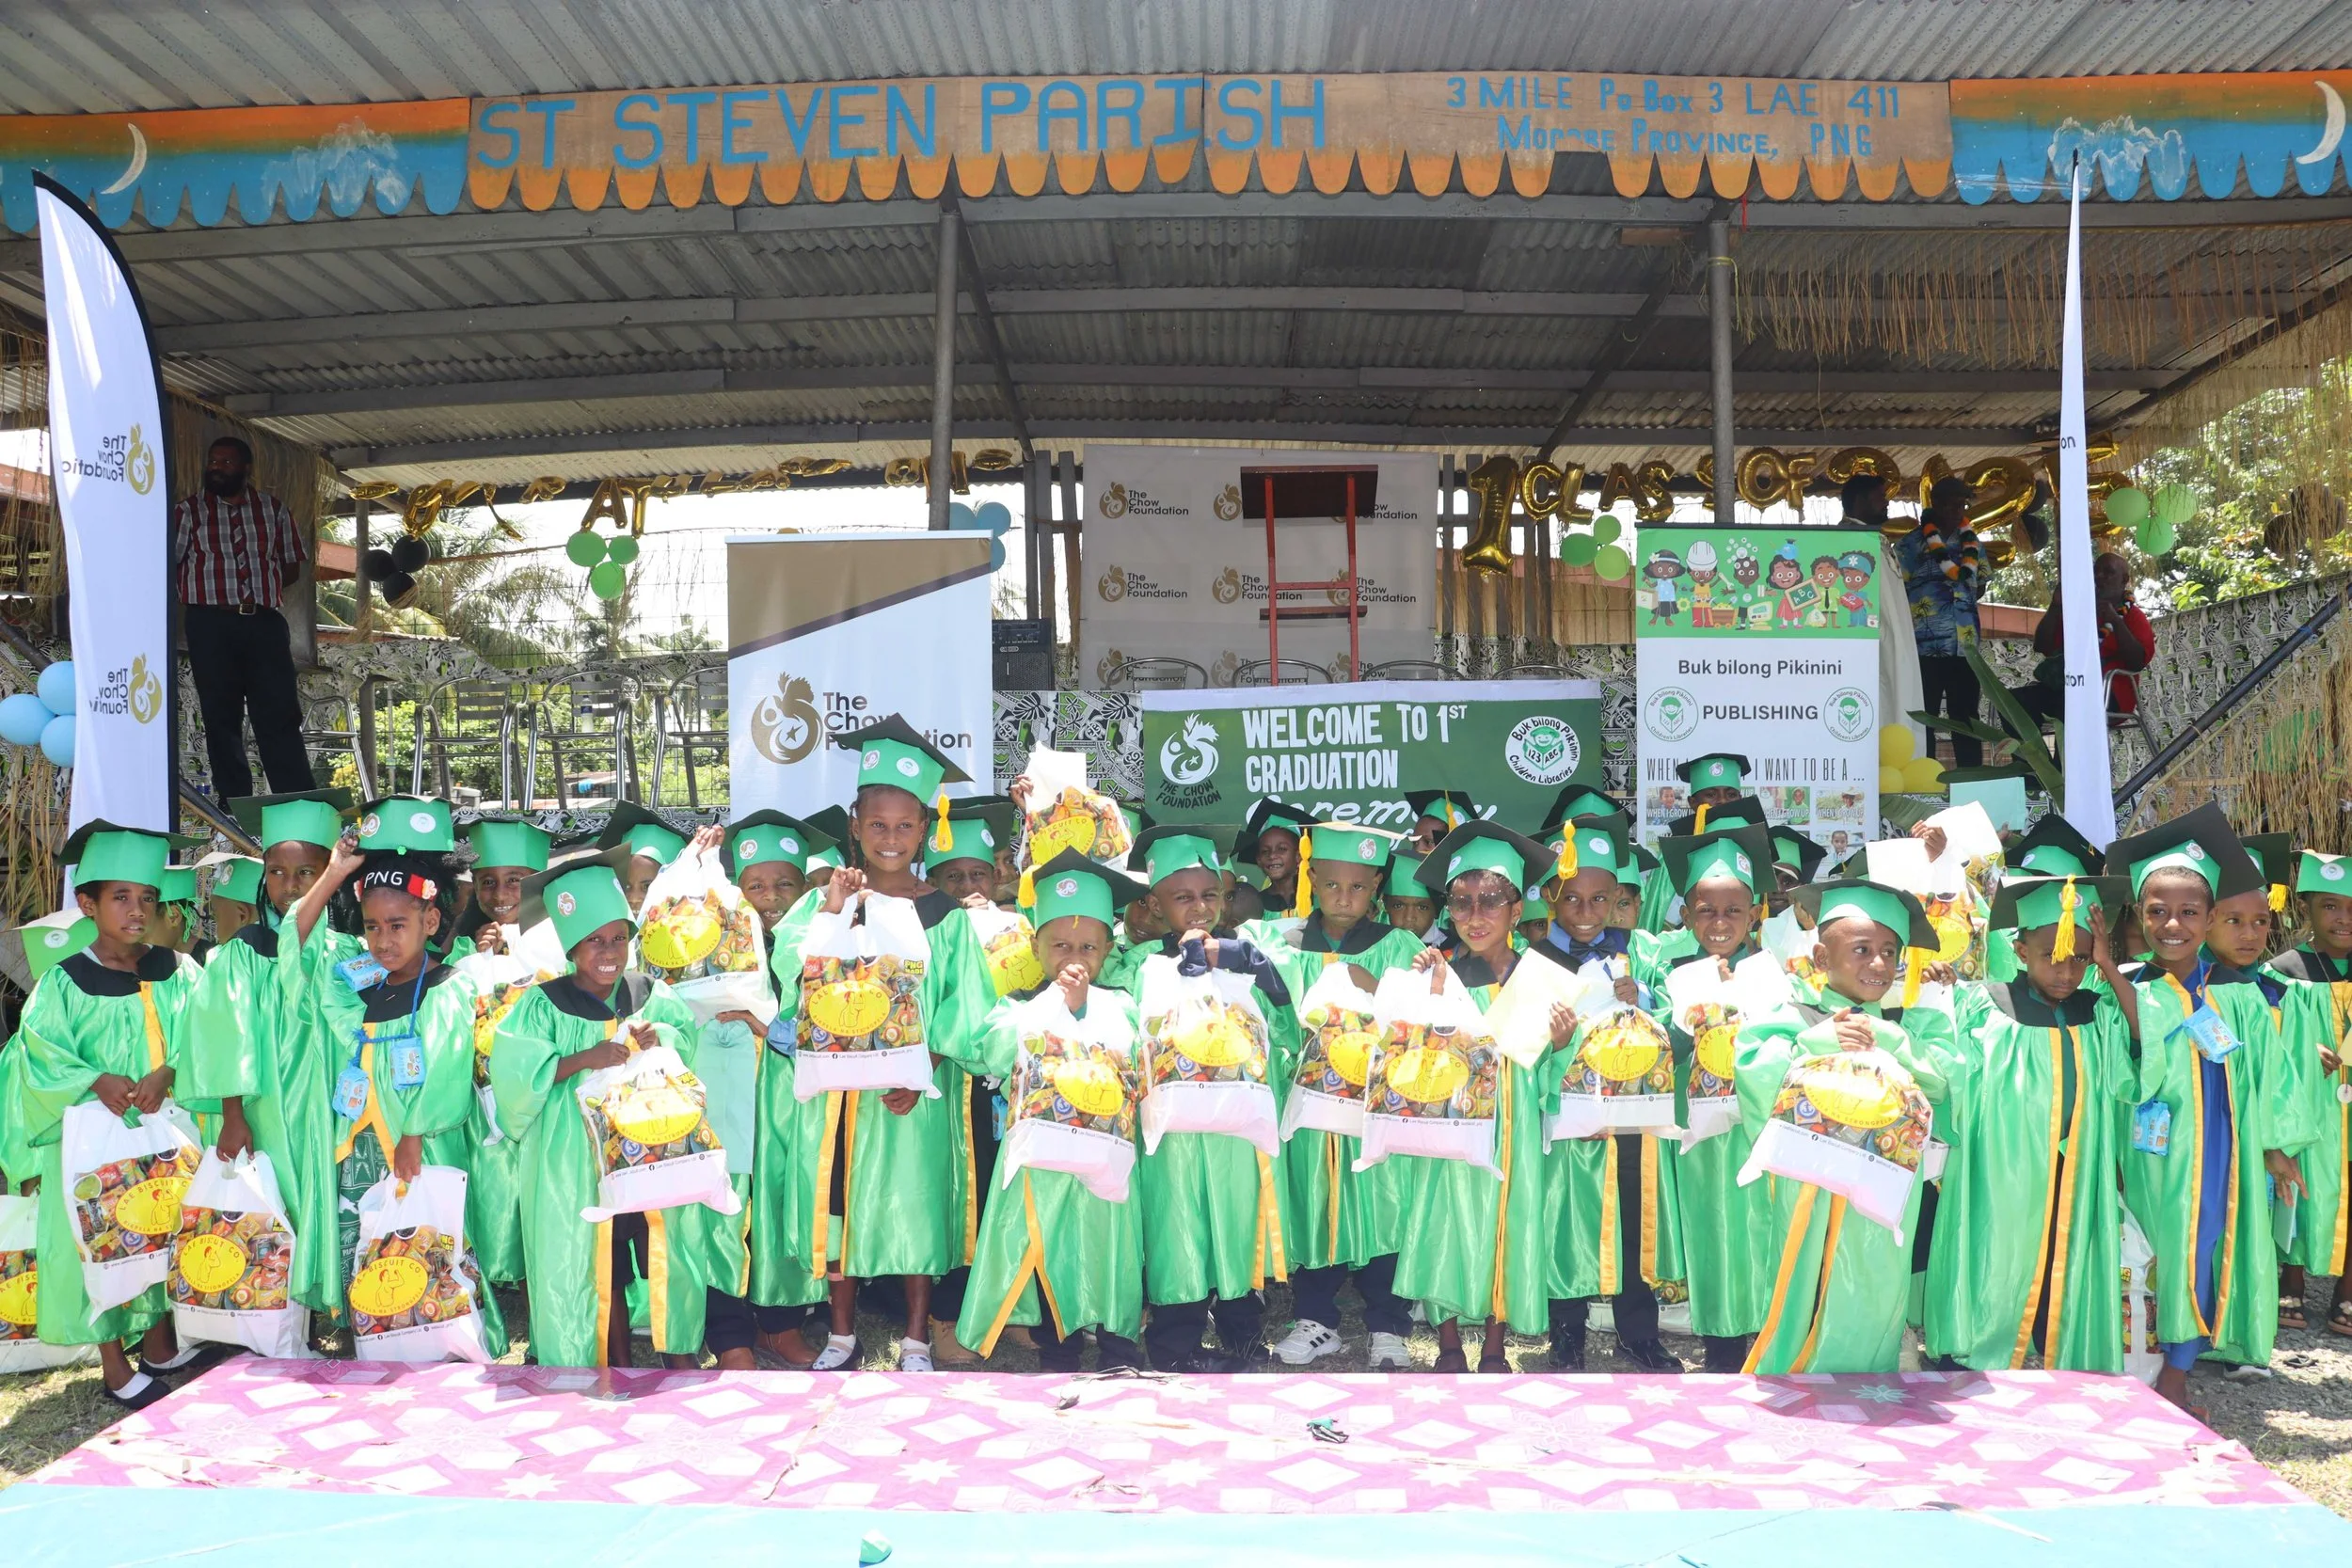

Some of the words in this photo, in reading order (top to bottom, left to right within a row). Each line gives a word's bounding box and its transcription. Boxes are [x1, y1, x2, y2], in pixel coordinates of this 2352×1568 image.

[1447, 77, 1467, 108] 3
[1480, 77, 1573, 110] MILE
[1708, 83, 1724, 114] 3
[1746, 85, 1819, 117] LAE
[1847, 86, 1899, 119] 411
[478, 100, 576, 168] ST
[613, 85, 937, 168] STEVEN
[981, 78, 1327, 153] PARISH
[1810, 123, 1872, 157] PNG
[1738, 447, 1817, 515] OF
[1128, 489, 1147, 499] The
[1128, 499, 1159, 508] Chow
[1128, 506, 1189, 516] Foundation
[1127, 573, 1146, 582] The
[1242, 575, 1261, 583] The
[1356, 577, 1375, 585] The
[1127, 581, 1158, 591] Chow
[1356, 585, 1387, 594] Chow
[1127, 589, 1188, 599] Foundation
[1242, 591, 1303, 600] Founation
[1356, 593, 1417, 603] Foundation
[1678, 660, 1711, 674] Buk
[1717, 660, 1772, 677] bilong
[1777, 660, 1842, 674] Pikinini
[823, 691, 867, 711] The
[1703, 705, 1819, 720] PUBLISHING
[1242, 704, 1382, 749] WELCOME
[1396, 703, 1427, 743] TO
[1531, 718, 1561, 730] bilong
[1529, 749, 1541, 763] 123
[1545, 749, 1559, 764] ABC
[1245, 750, 1398, 793] GRADUATION
[1510, 755, 1536, 782] Children
[1538, 767, 1573, 784] Libraries
[1764, 758, 1796, 781] WANT
[1804, 758, 1817, 781] TO
[1823, 758, 1836, 781] BE
[1841, 758, 1848, 781] A
[1159, 779, 1179, 796] THE
[1184, 779, 1214, 796] CHOW
[1155, 791, 1222, 810] FOUNDATION
[1646, 809, 1666, 817] WHEN
[1669, 809, 1688, 817] GROW
[364, 871, 404, 887] PNG
[904, 959, 924, 969] PNG
[812, 989, 828, 1005] LAE
[119, 1194, 135, 1211] LAE
[138, 1180, 174, 1193] BISCUIT
[369, 1259, 405, 1273] BISCUIT
